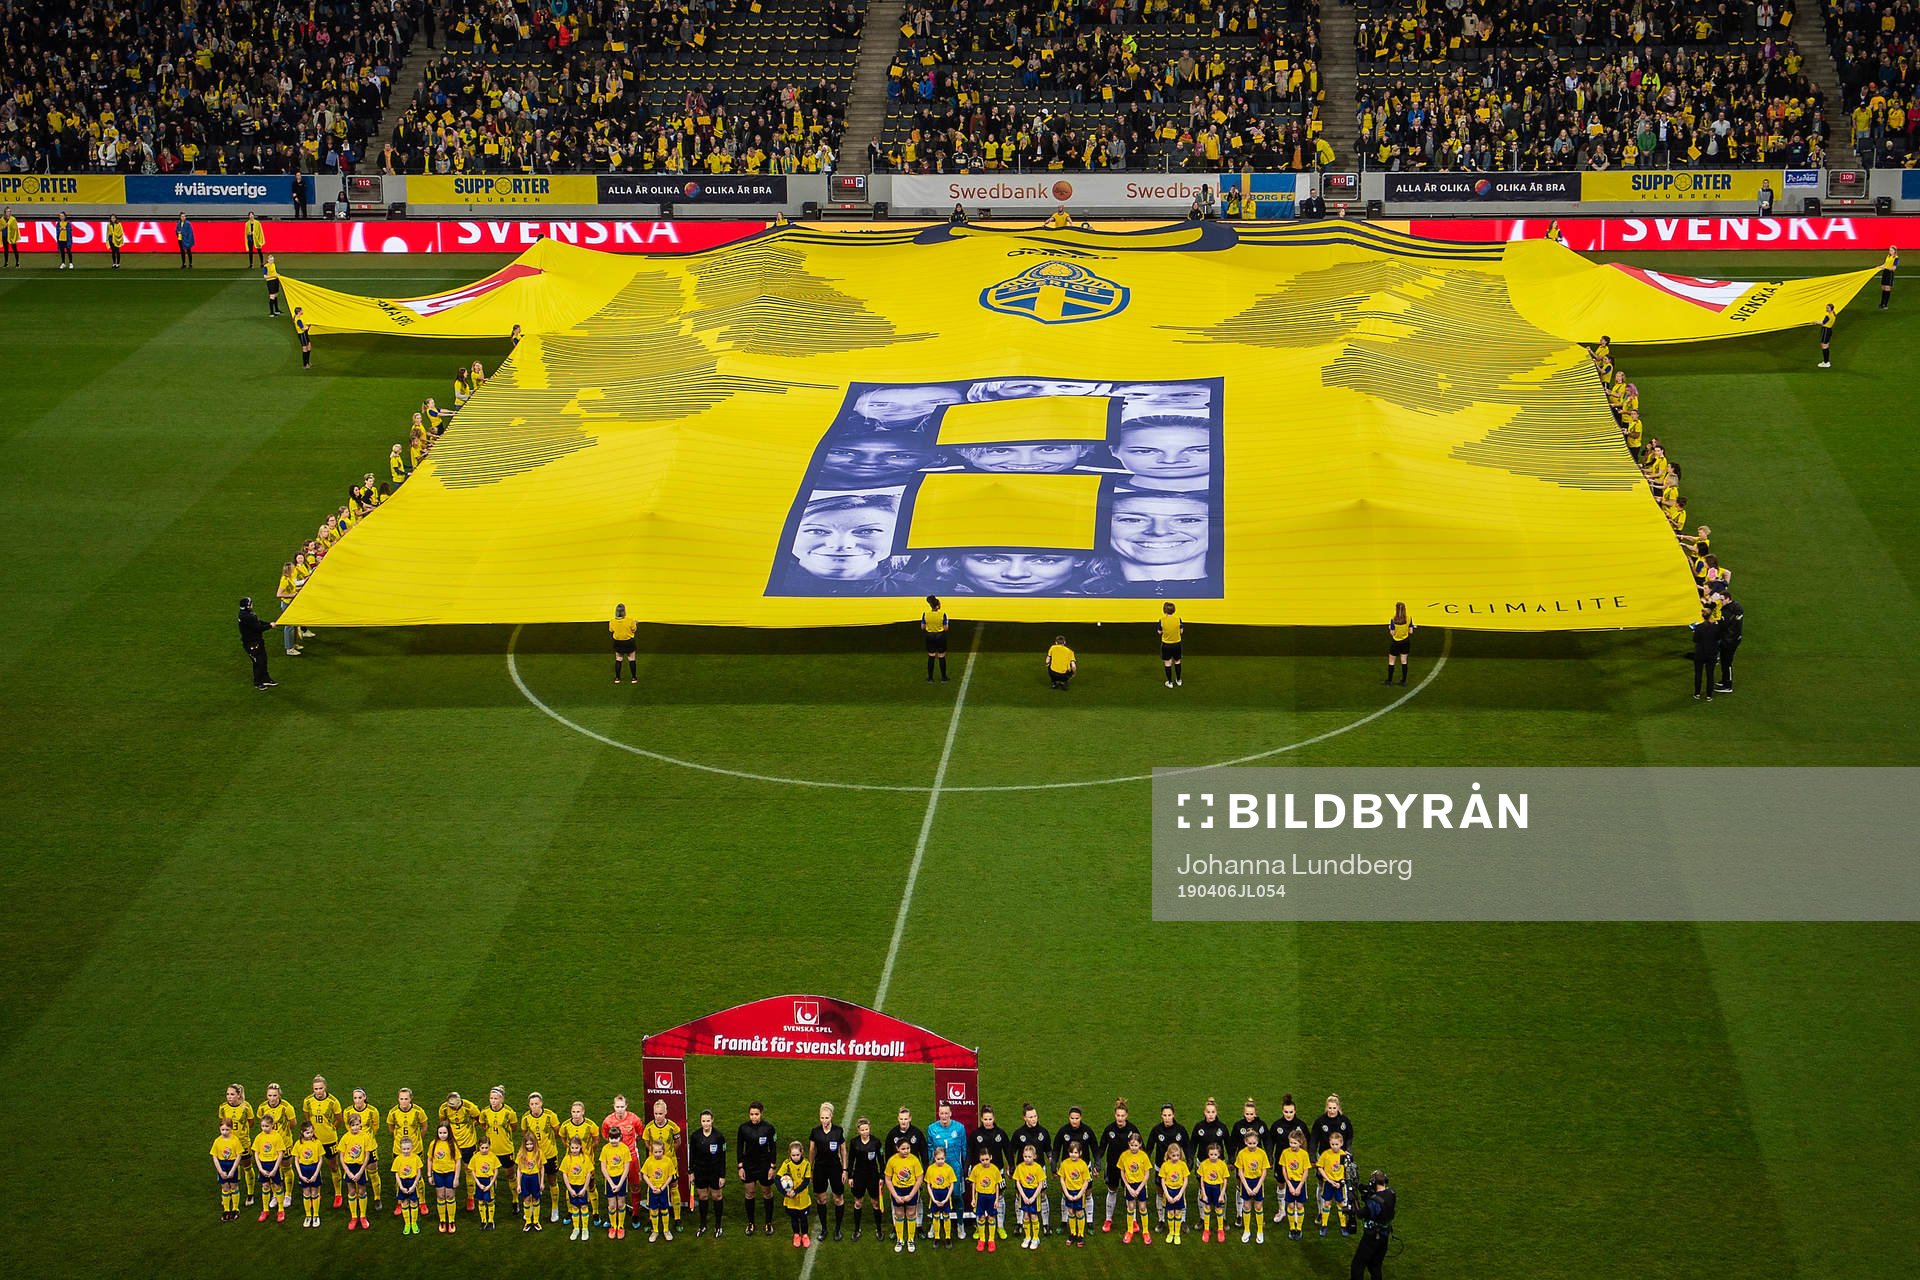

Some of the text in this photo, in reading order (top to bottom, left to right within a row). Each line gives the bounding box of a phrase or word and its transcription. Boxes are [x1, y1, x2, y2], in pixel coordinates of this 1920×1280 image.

[0, 176, 78, 194] PPORTER
[174, 182, 267, 198] #viärsverige
[454, 176, 550, 195] SUPPORTER
[608, 186, 633, 194] ALLA
[650, 186, 680, 194] OLIKA
[705, 186, 735, 194] OLIKA
[753, 186, 772, 194] BRA
[1395, 184, 1421, 193] ALLA
[1440, 184, 1470, 192] OLIKA
[1496, 183, 1527, 192] OLIKA
[1546, 183, 1566, 192] BRA
[1631, 173, 1732, 191] SUPPORTER
[949, 183, 1049, 199] Swedbank
[457, 221, 679, 245] SVENSKA
[1622, 217, 1857, 242] SVENSKA
[1007, 280, 1101, 293] SVERIGE
[1730, 286, 1778, 321] SVENSKA
[1444, 596, 1627, 614] CLIMALITE
[783, 1025, 814, 1033] SVENSKA
[713, 1034, 905, 1057] Framåt för svensk fotboll!
[314, 1115, 324, 1124] 18
[403, 1127, 409, 1136] 6
[493, 1126, 499, 1135] 4
